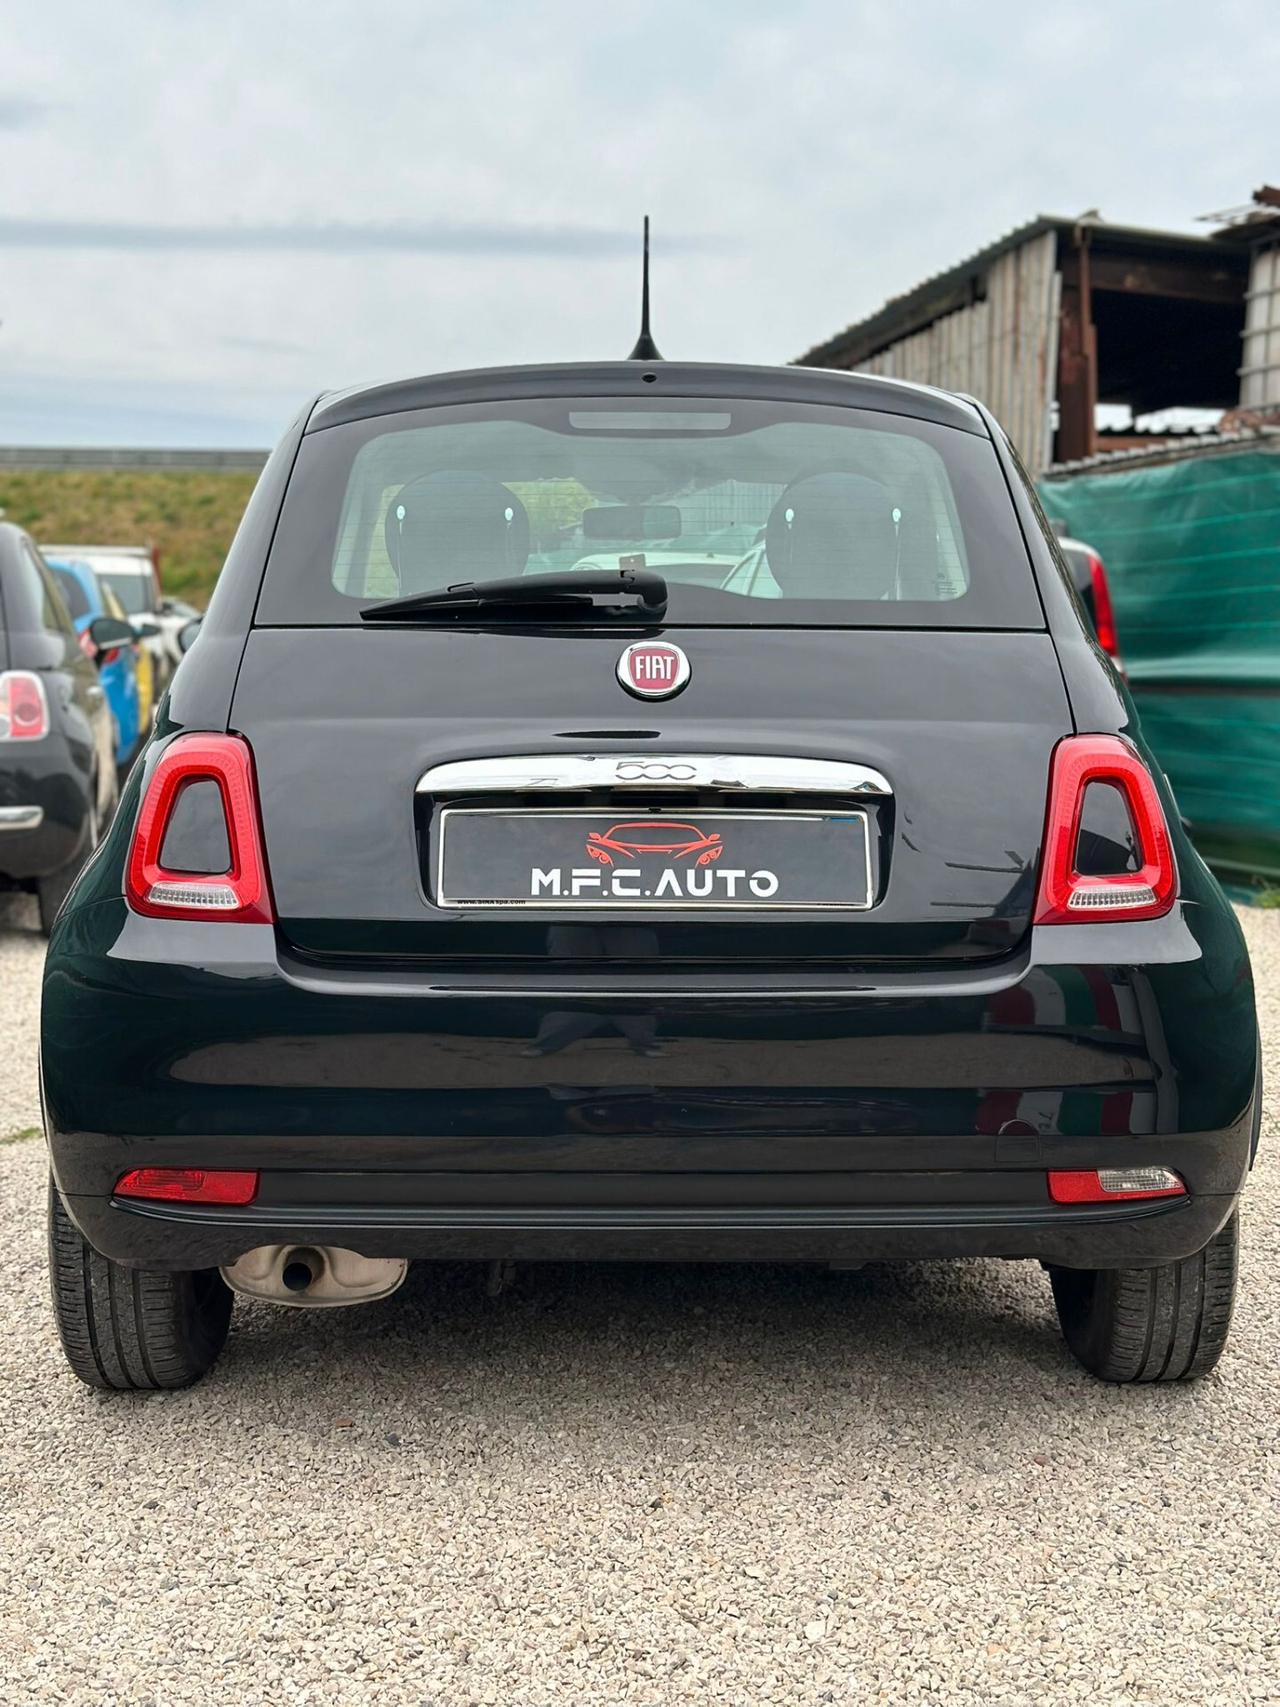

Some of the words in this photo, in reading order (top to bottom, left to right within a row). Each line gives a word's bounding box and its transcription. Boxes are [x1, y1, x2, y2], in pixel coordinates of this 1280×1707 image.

[635, 655, 674, 680] FIAT
[615, 761, 697, 781] 500
[531, 868, 779, 897] M.F.C.AUTO
